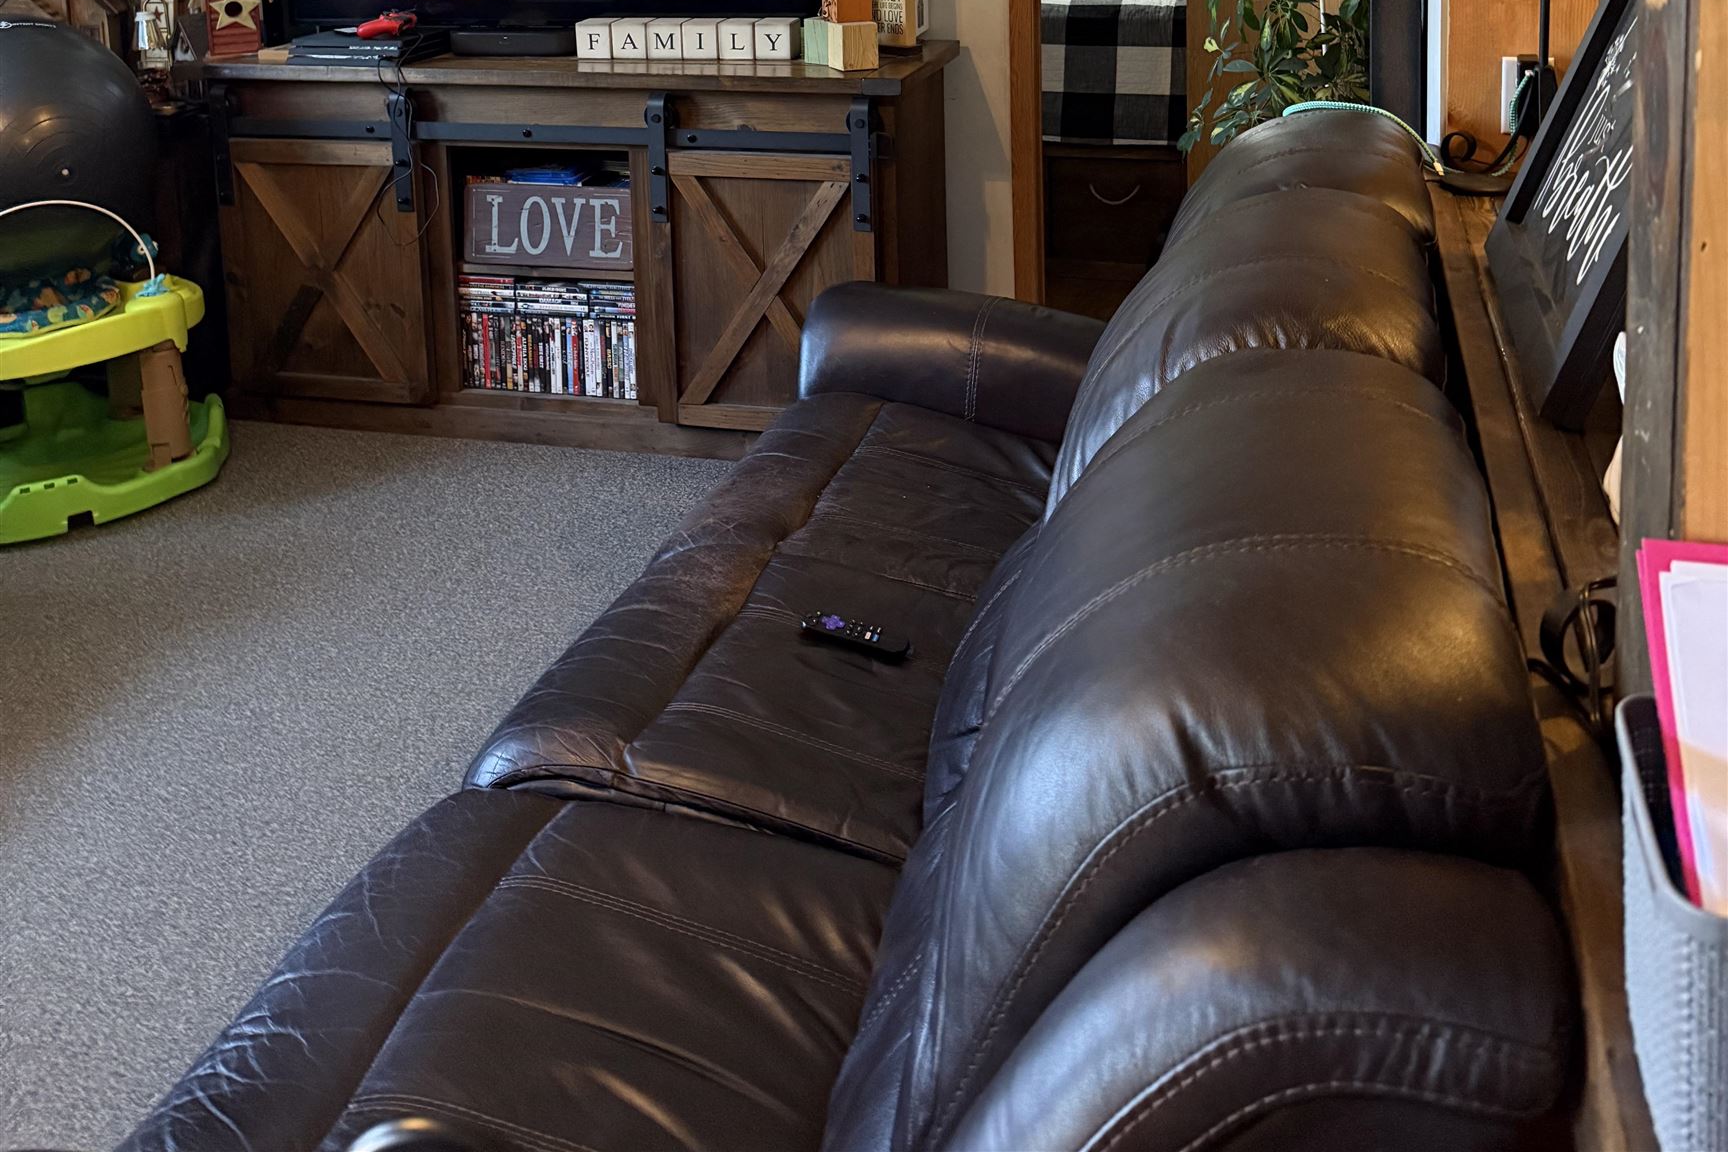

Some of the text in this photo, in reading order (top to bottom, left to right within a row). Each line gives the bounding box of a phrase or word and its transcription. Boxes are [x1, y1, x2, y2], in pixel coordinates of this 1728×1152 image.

[884, 10, 903, 23] LOVE
[886, 23, 904, 35] ENDS
[485, 194, 623, 258] LOVE
